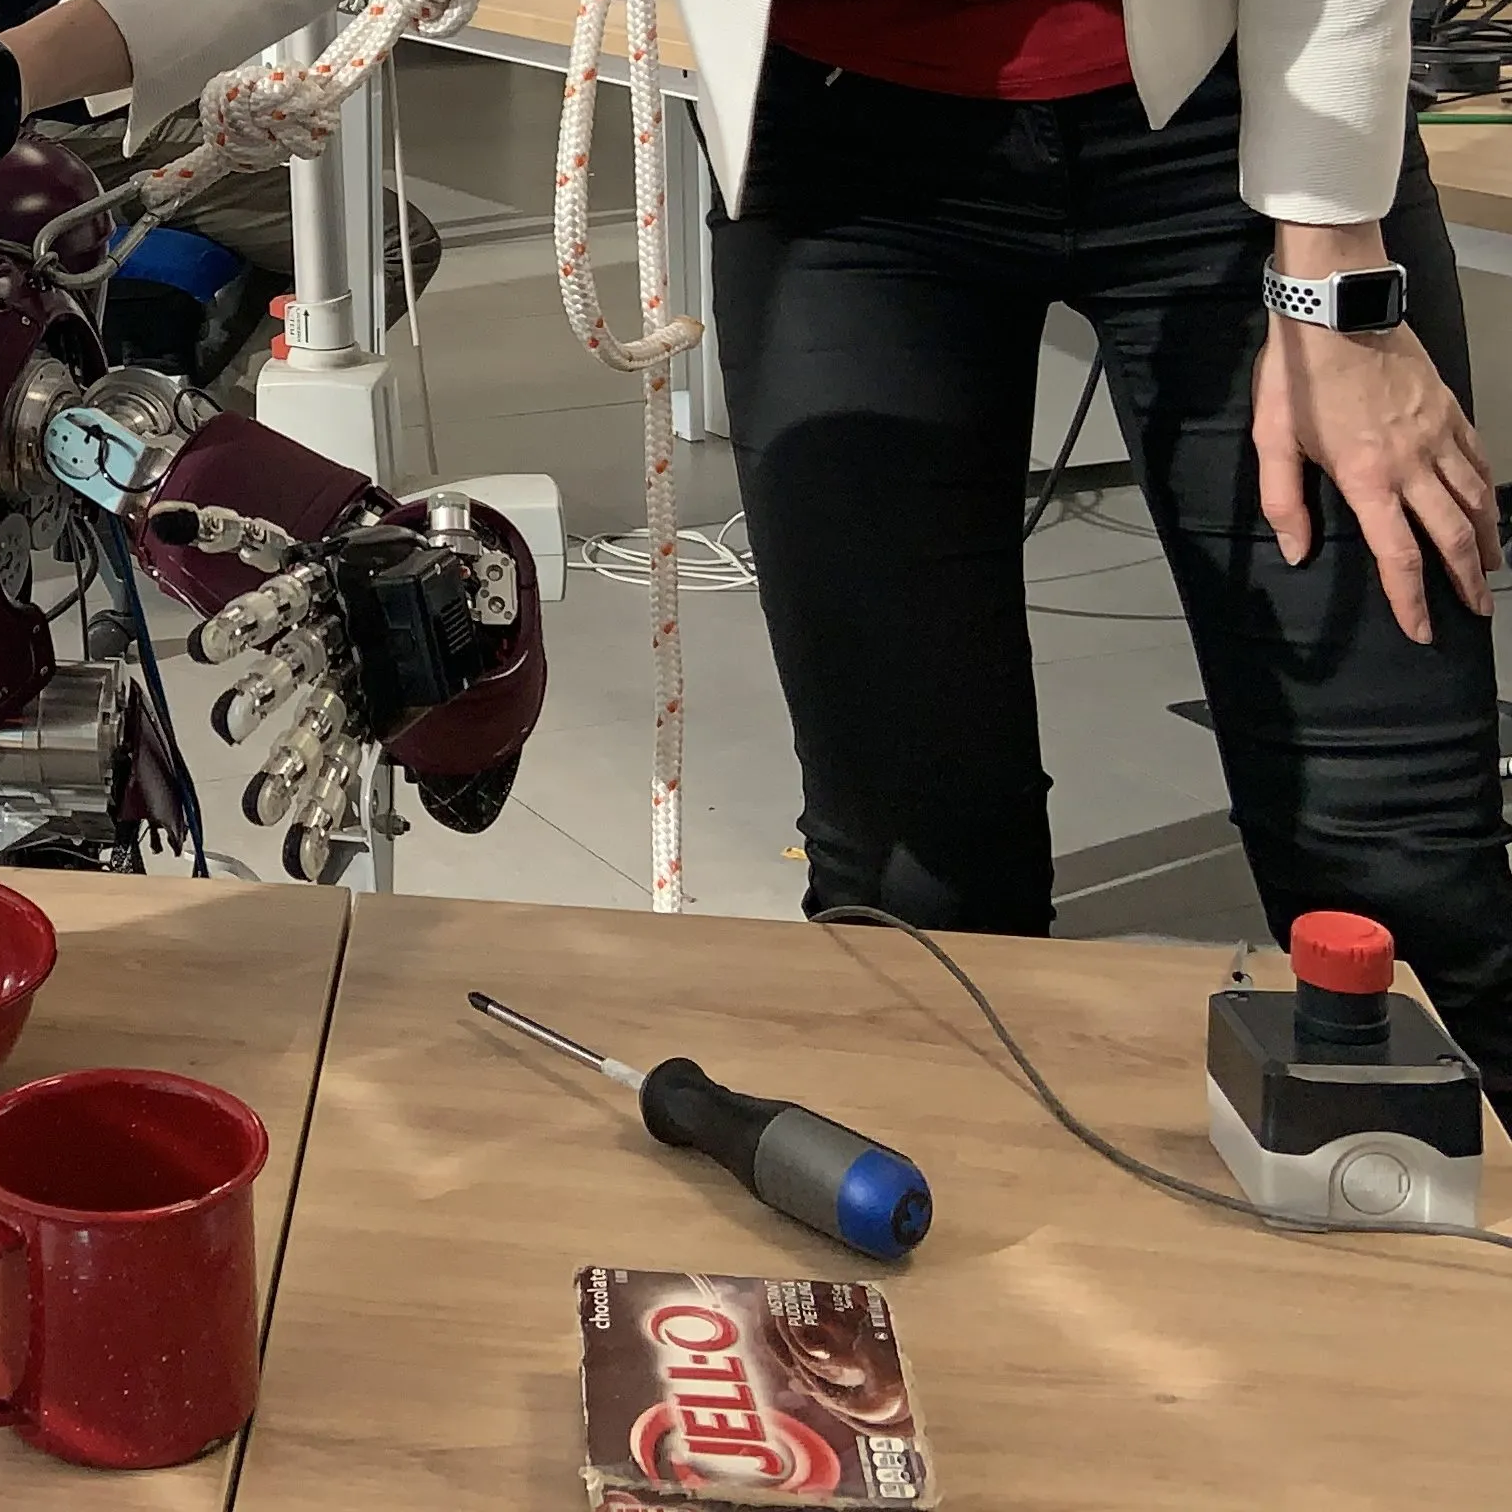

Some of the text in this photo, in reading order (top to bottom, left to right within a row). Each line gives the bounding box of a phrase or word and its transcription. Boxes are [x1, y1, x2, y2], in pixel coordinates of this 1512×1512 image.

[586, 1268, 610, 1329] chocolate
[764, 1279, 785, 1317] INSTANT
[782, 1287, 803, 1327] PUDDING
